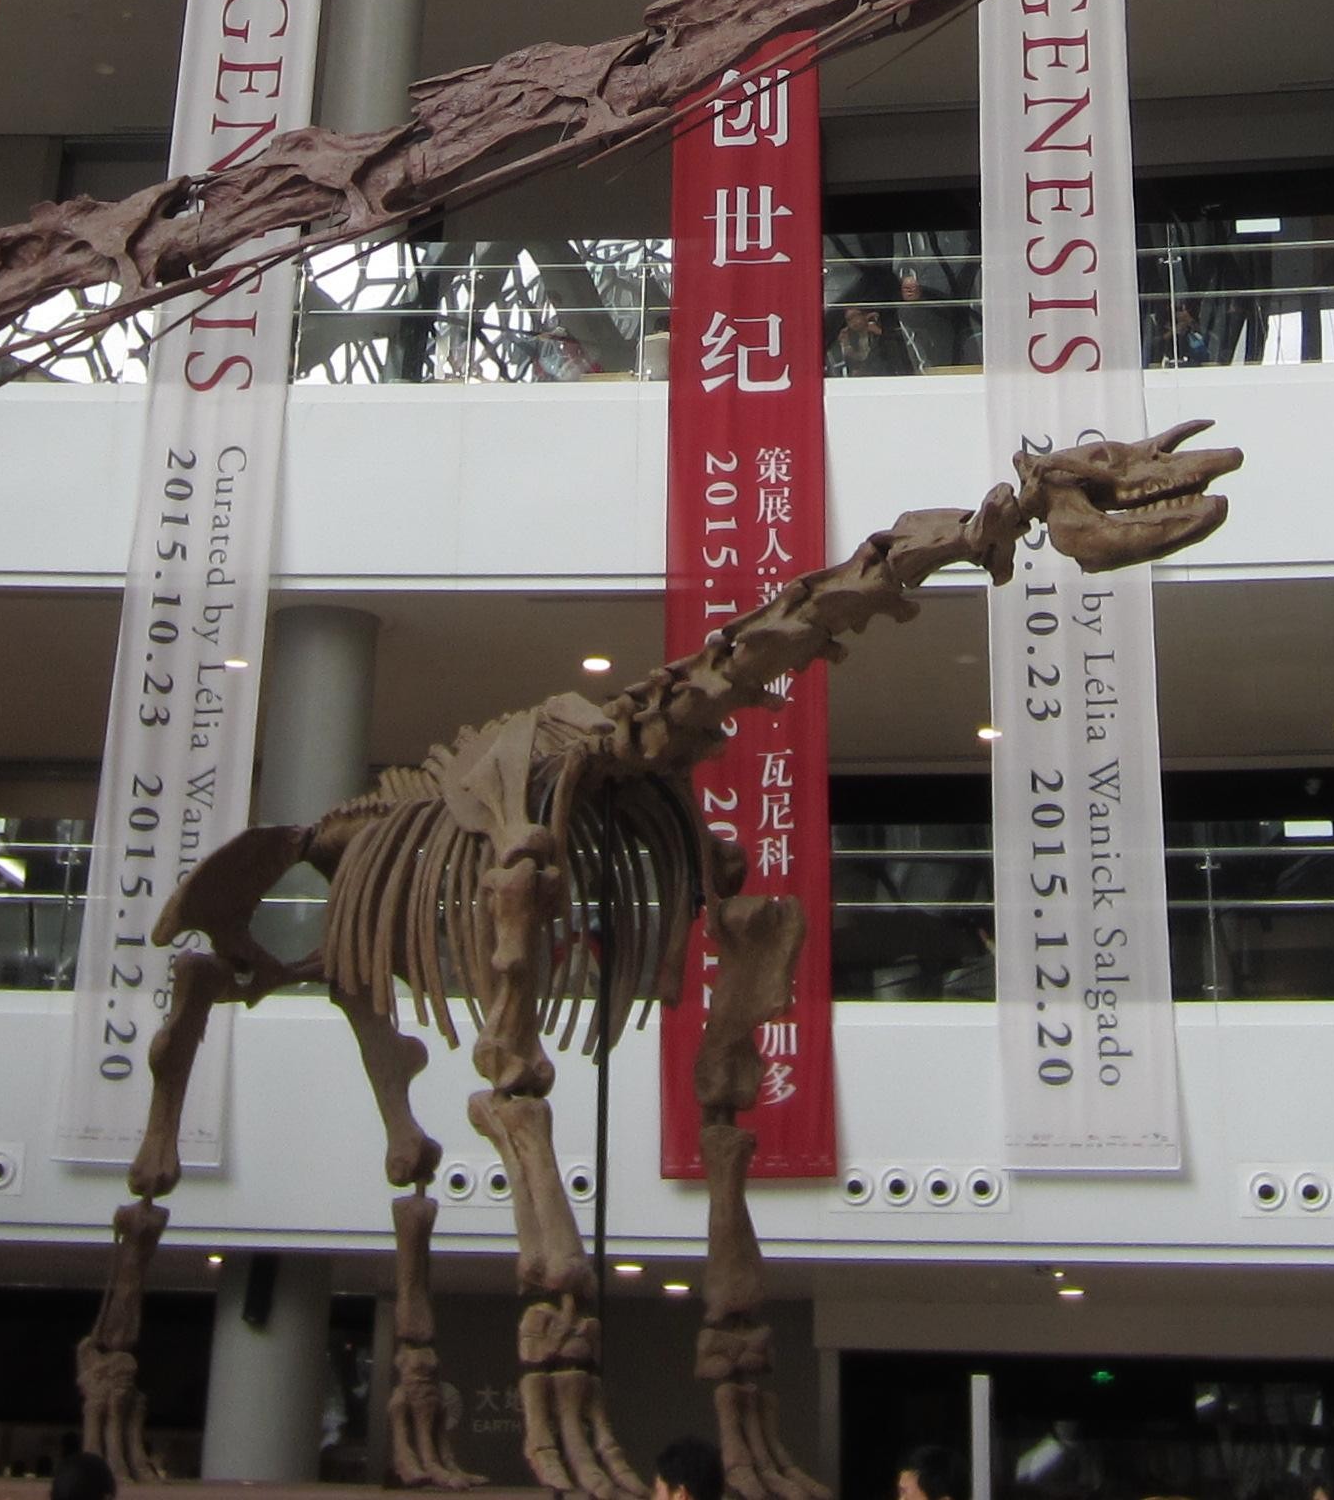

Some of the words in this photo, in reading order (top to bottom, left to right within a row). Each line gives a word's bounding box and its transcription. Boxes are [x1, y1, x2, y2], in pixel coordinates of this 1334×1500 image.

[700, 68, 793, 394] 创世纪
[138, 448, 198, 729] 2015.10.23
[205, 445, 248, 590] Curated
[1020, 433, 1062, 723] 25.10.23
[191, 603, 235, 645] by
[1072, 590, 1115, 635] by
[188, 660, 227, 752] Lélia
[1083, 651, 1117, 743] Lélia
[176, 767, 217, 886] Wani
[1086, 758, 1128, 910] Wanick
[99, 773, 164, 1081] 2015.12.20
[1030, 768, 1074, 1087] 2015.12.20
[1084, 926, 1134, 1087] Salgado
